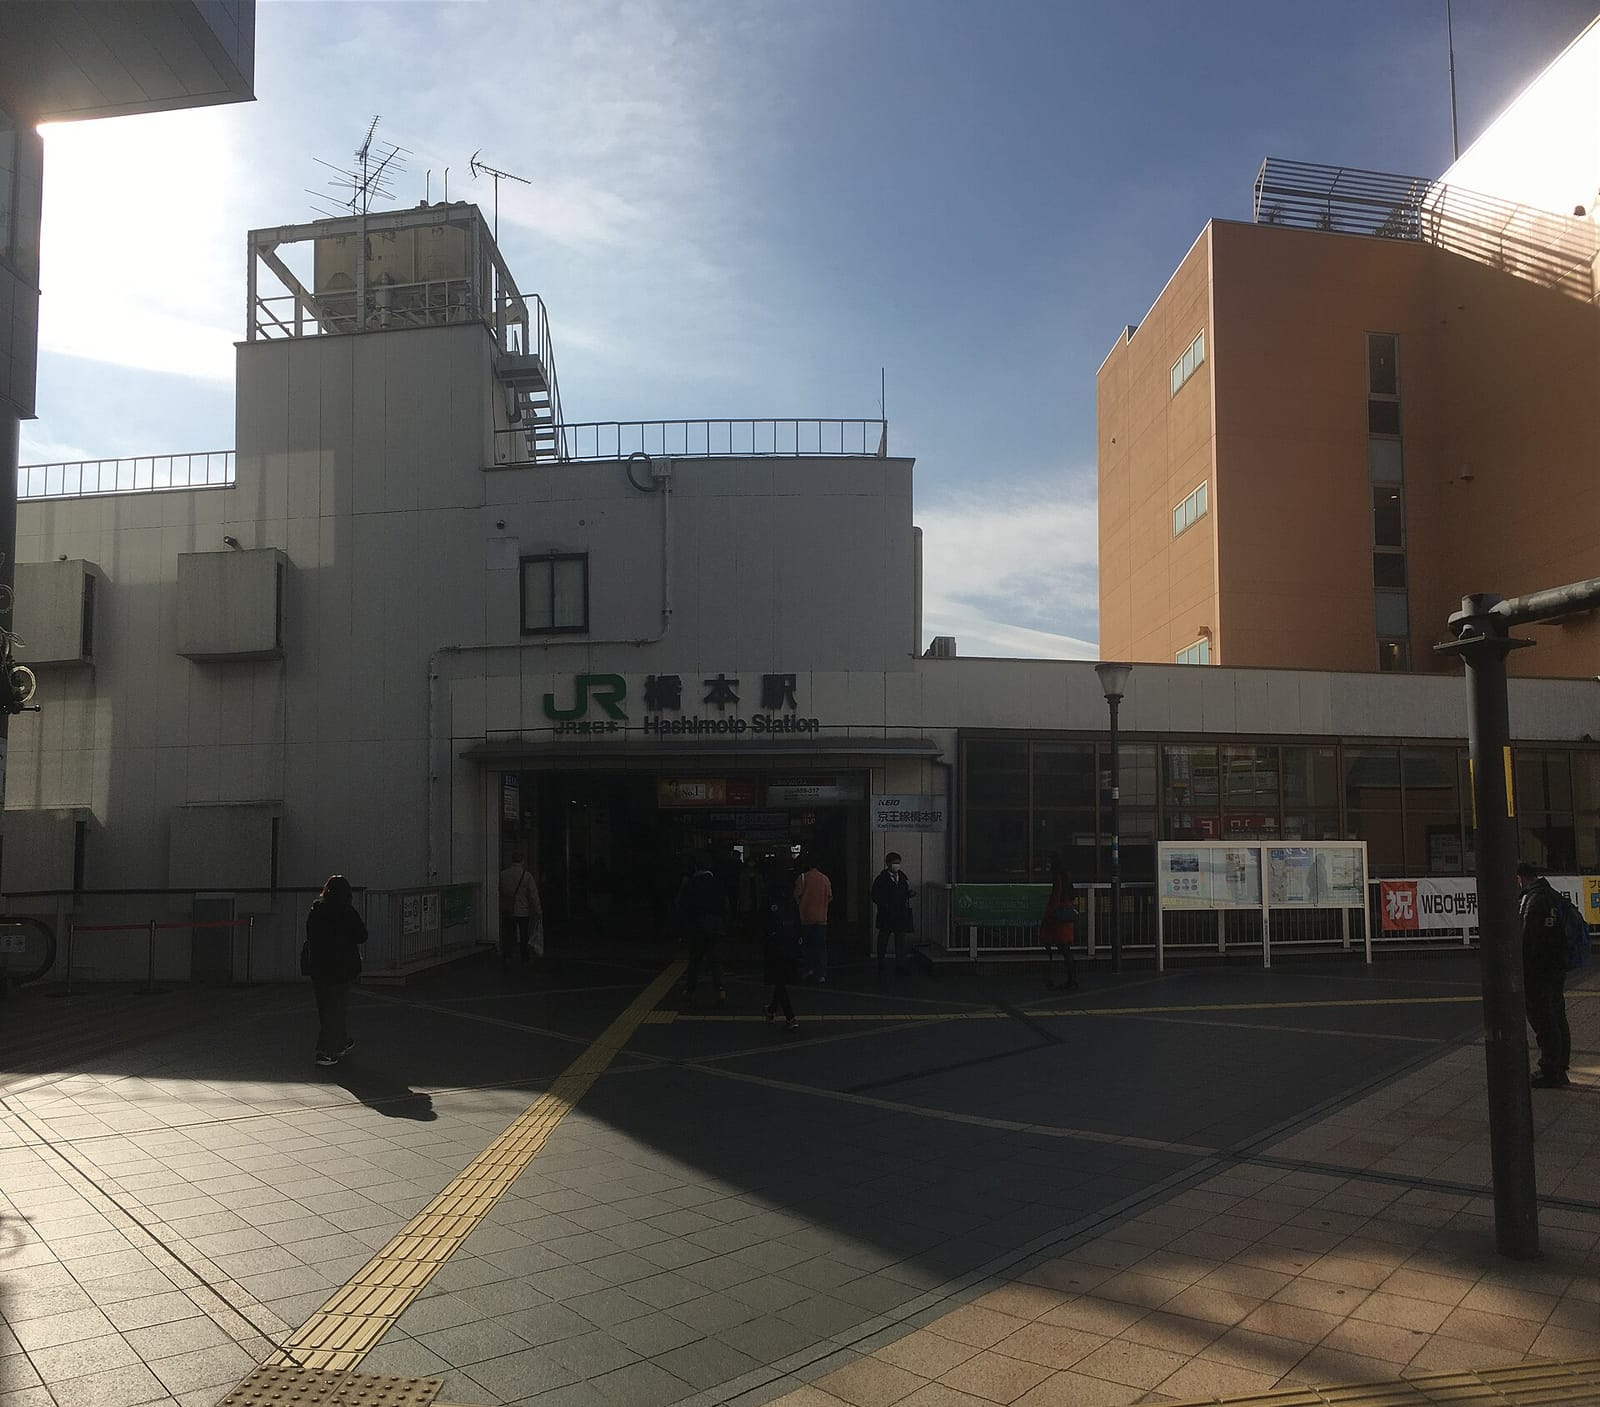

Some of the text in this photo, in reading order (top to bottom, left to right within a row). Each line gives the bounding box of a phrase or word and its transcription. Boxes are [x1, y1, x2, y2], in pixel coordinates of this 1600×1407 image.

[543, 673, 629, 721] JR
[643, 673, 797, 711] 橋本駅
[555, 721, 619, 735] JR東日本
[643, 714, 819, 735] Hashimoto Station
[1385, 890, 1414, 920] 祝
[1421, 892, 1477, 915] WBO世界
